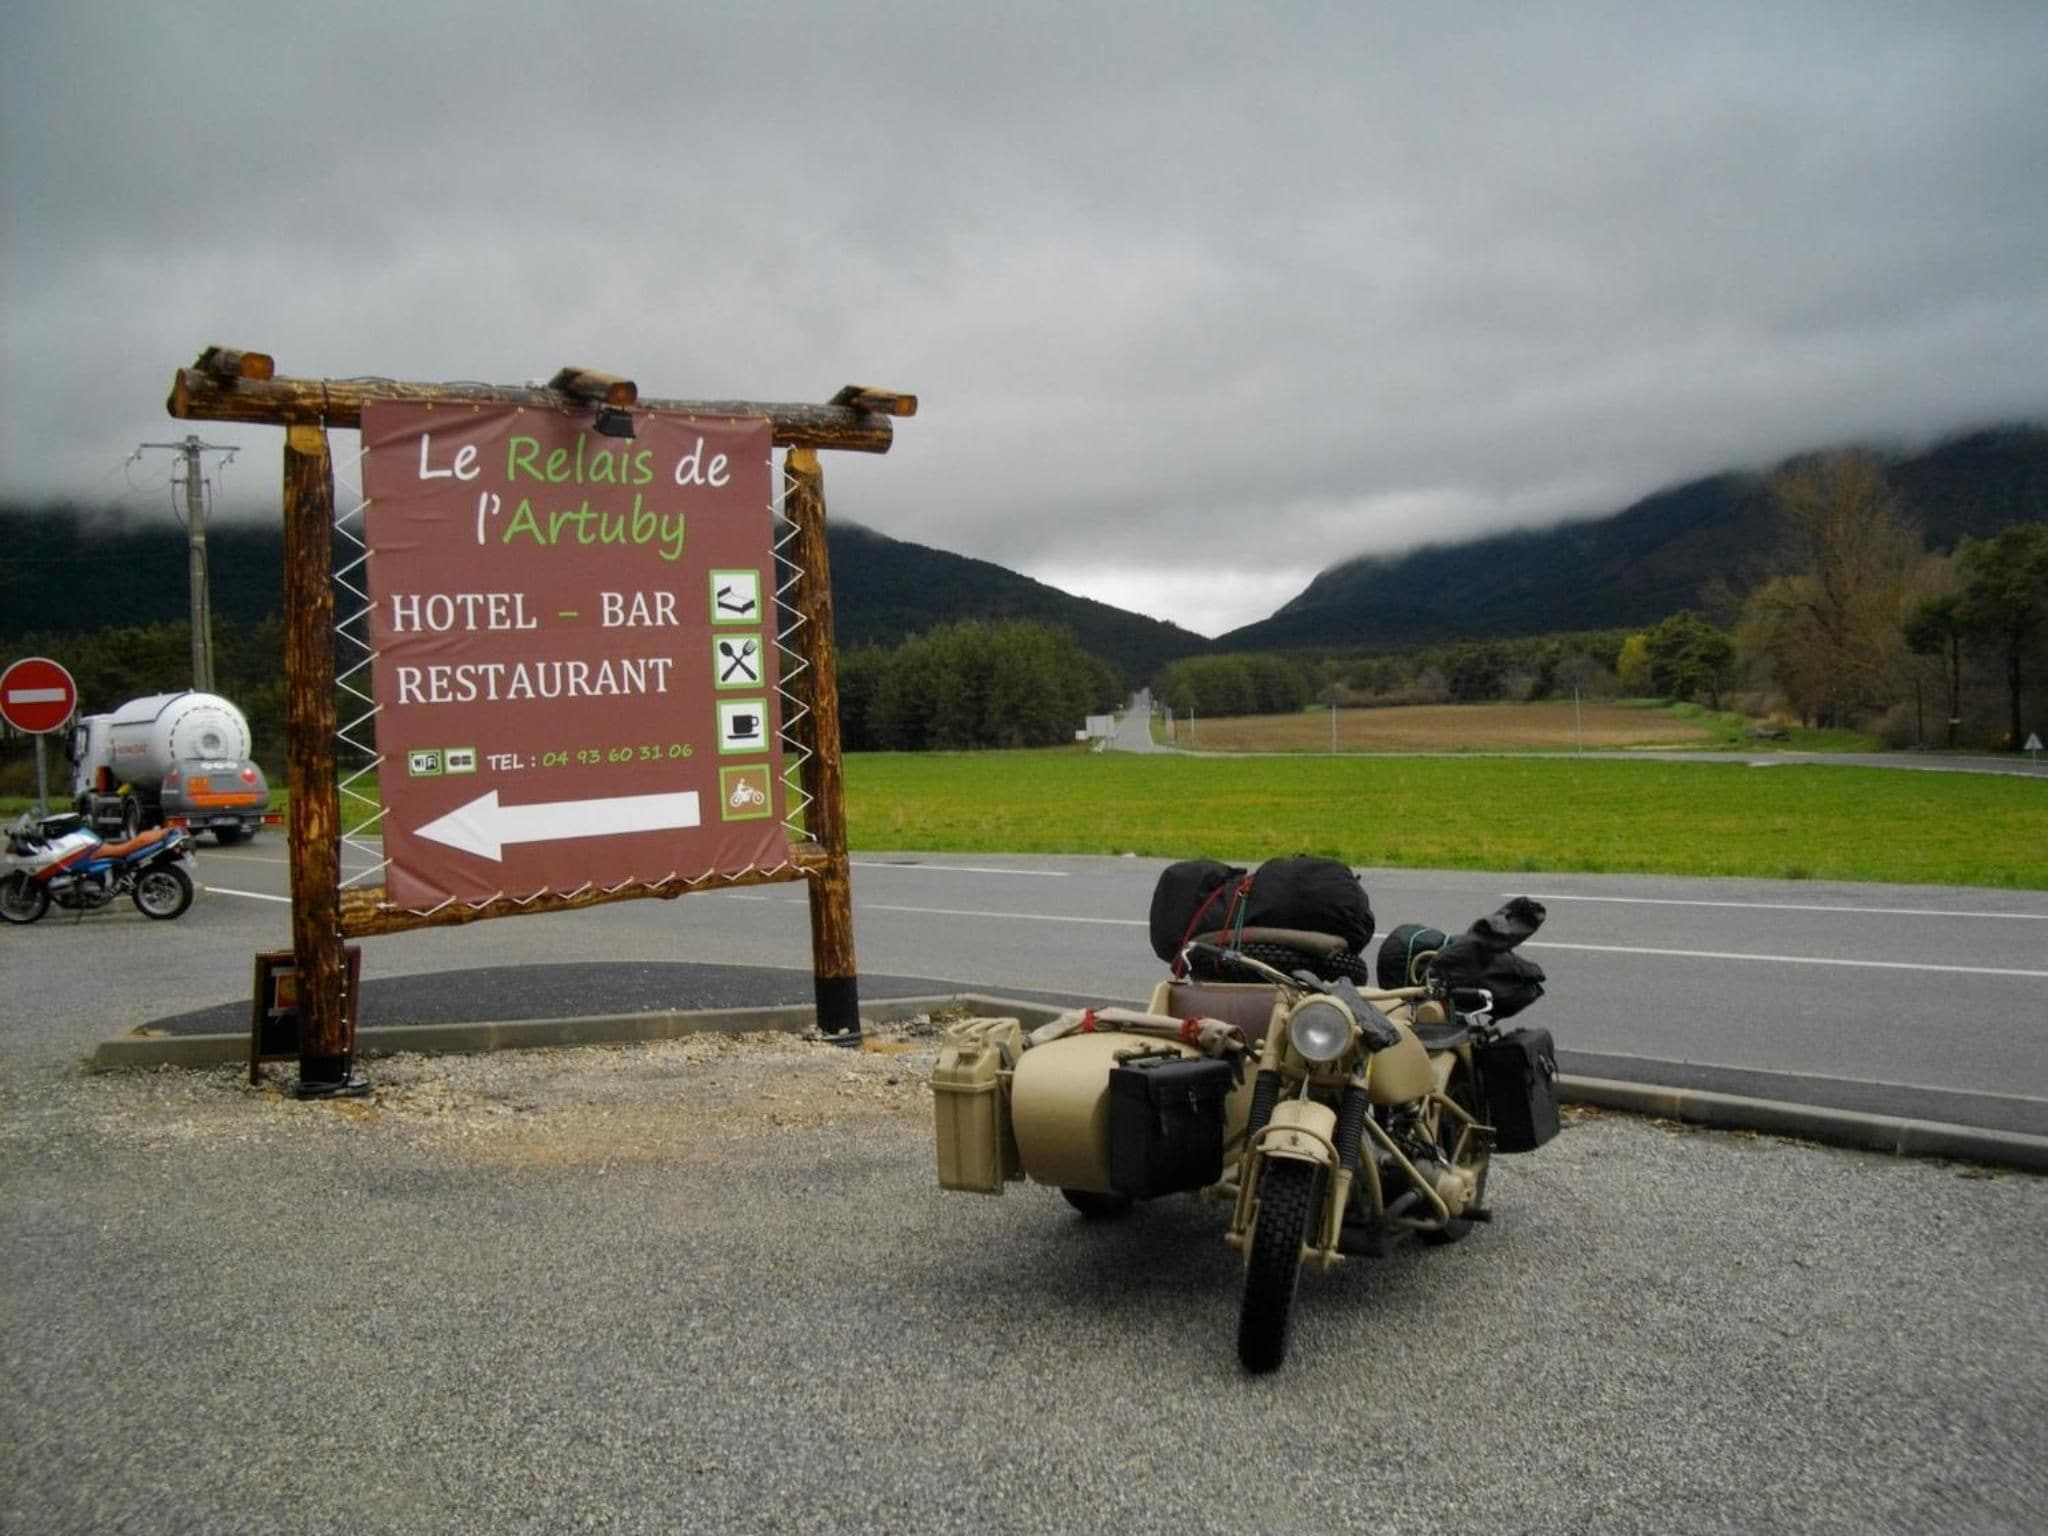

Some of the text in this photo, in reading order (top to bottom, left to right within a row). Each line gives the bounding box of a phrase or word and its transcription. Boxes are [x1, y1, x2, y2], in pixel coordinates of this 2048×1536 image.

[420, 433, 731, 488] Le Relais de
[477, 491, 686, 560] l'Artuby
[391, 593, 538, 632] HOTEL
[601, 592, 680, 627] BAR
[398, 658, 673, 704] RESTAURANT
[542, 751, 569, 767] 04
[576, 749, 601, 765] 93
[608, 747, 633, 763] 60
[639, 745, 663, 761] 31
[669, 743, 694, 759] 06
